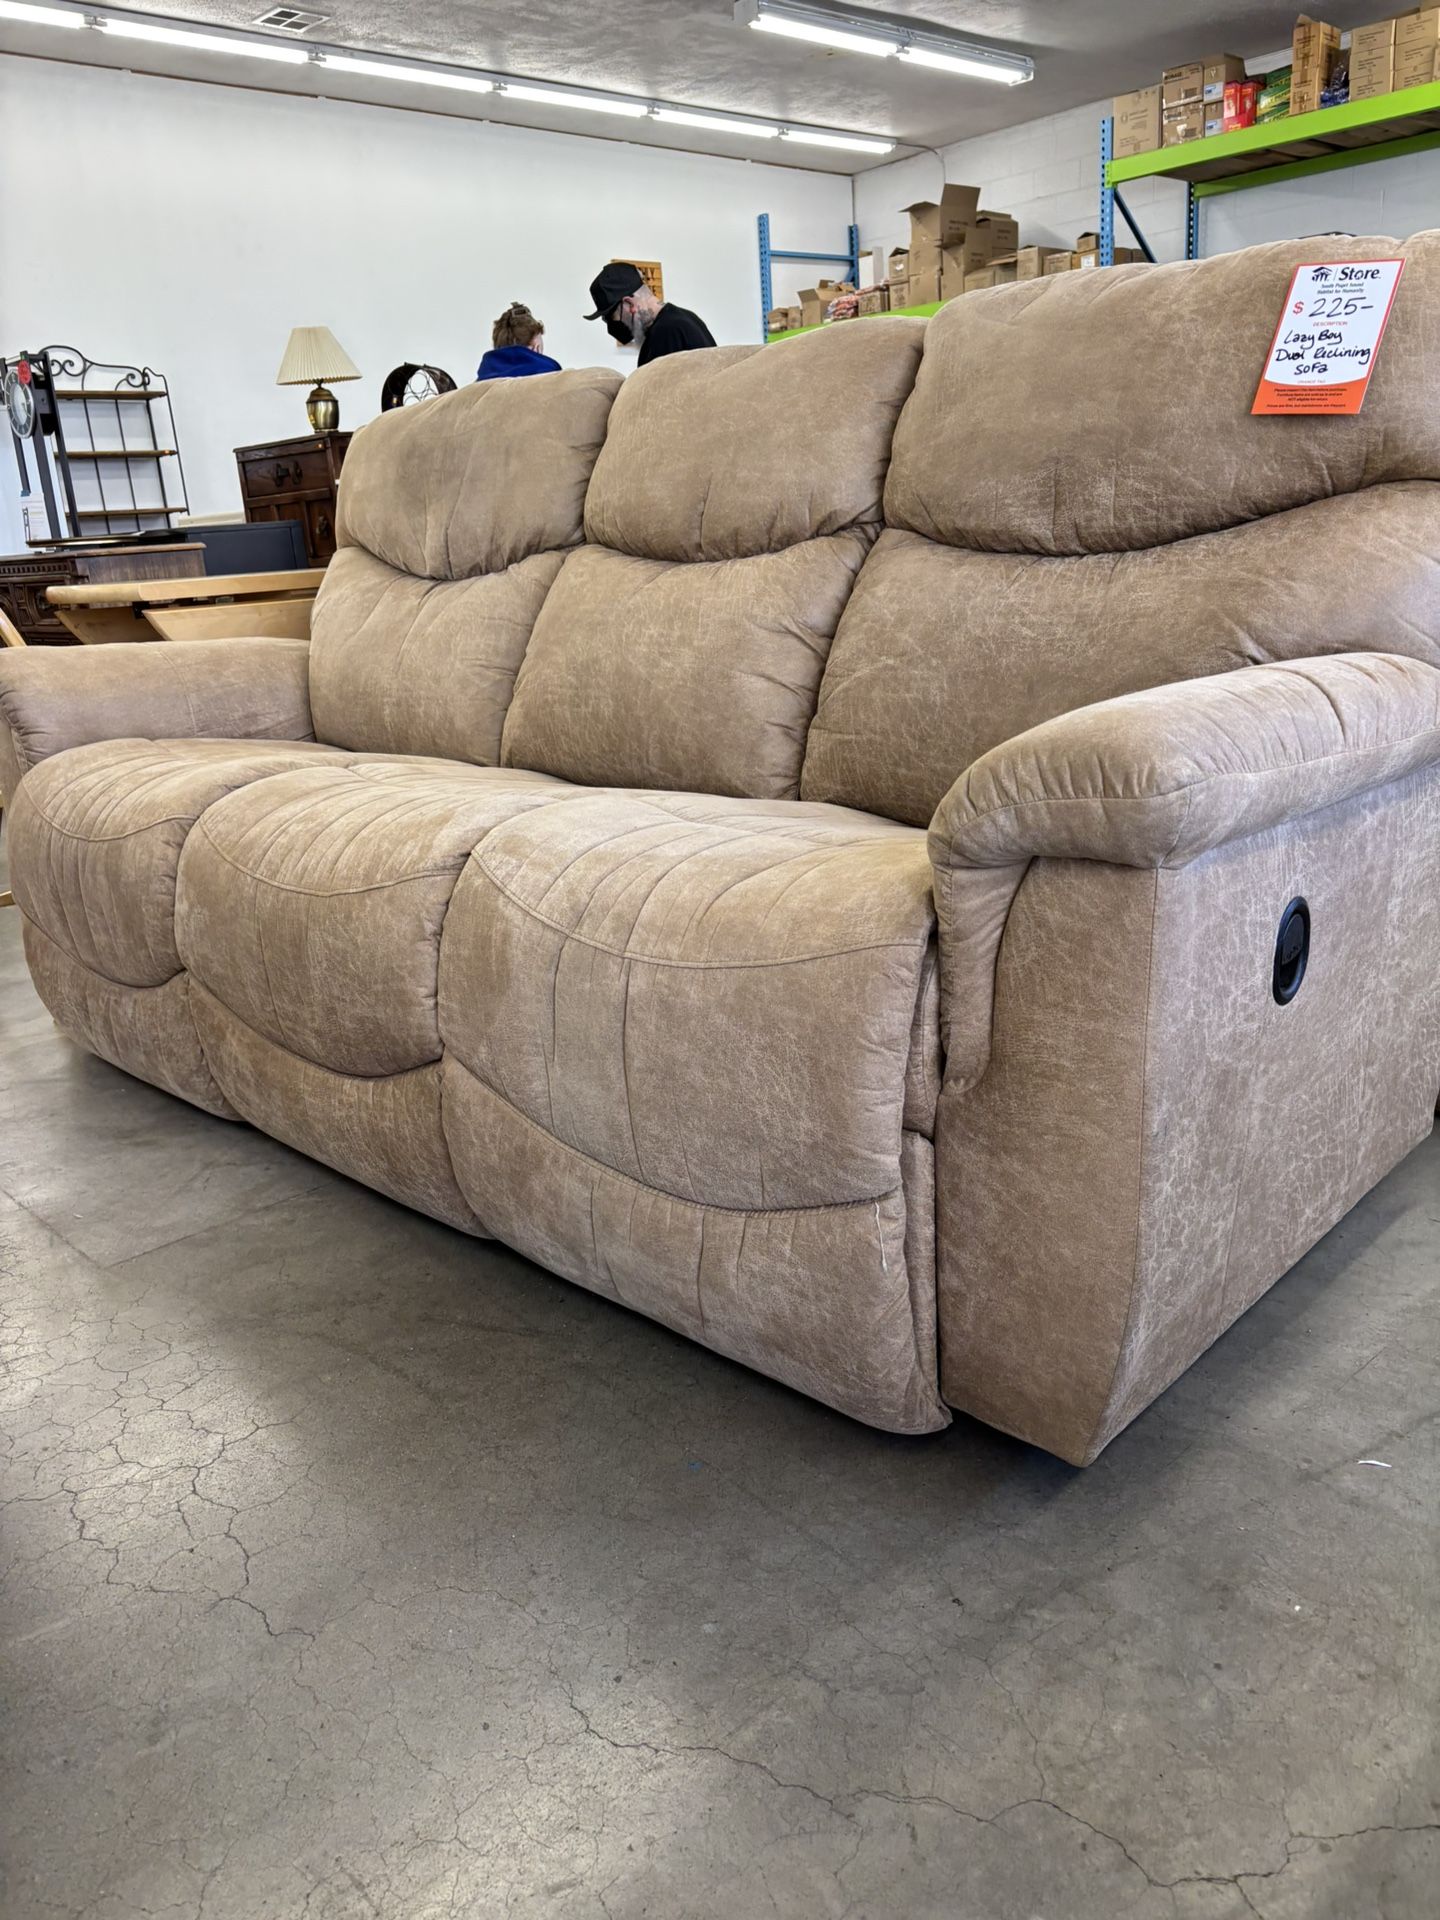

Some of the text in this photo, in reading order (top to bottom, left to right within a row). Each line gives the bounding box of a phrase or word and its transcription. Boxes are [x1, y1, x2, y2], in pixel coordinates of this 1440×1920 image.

[1338, 266, 1380, 281] Store
[1292, 300, 1305, 315] $
[1283, 329, 1343, 350] Lazy Boy
